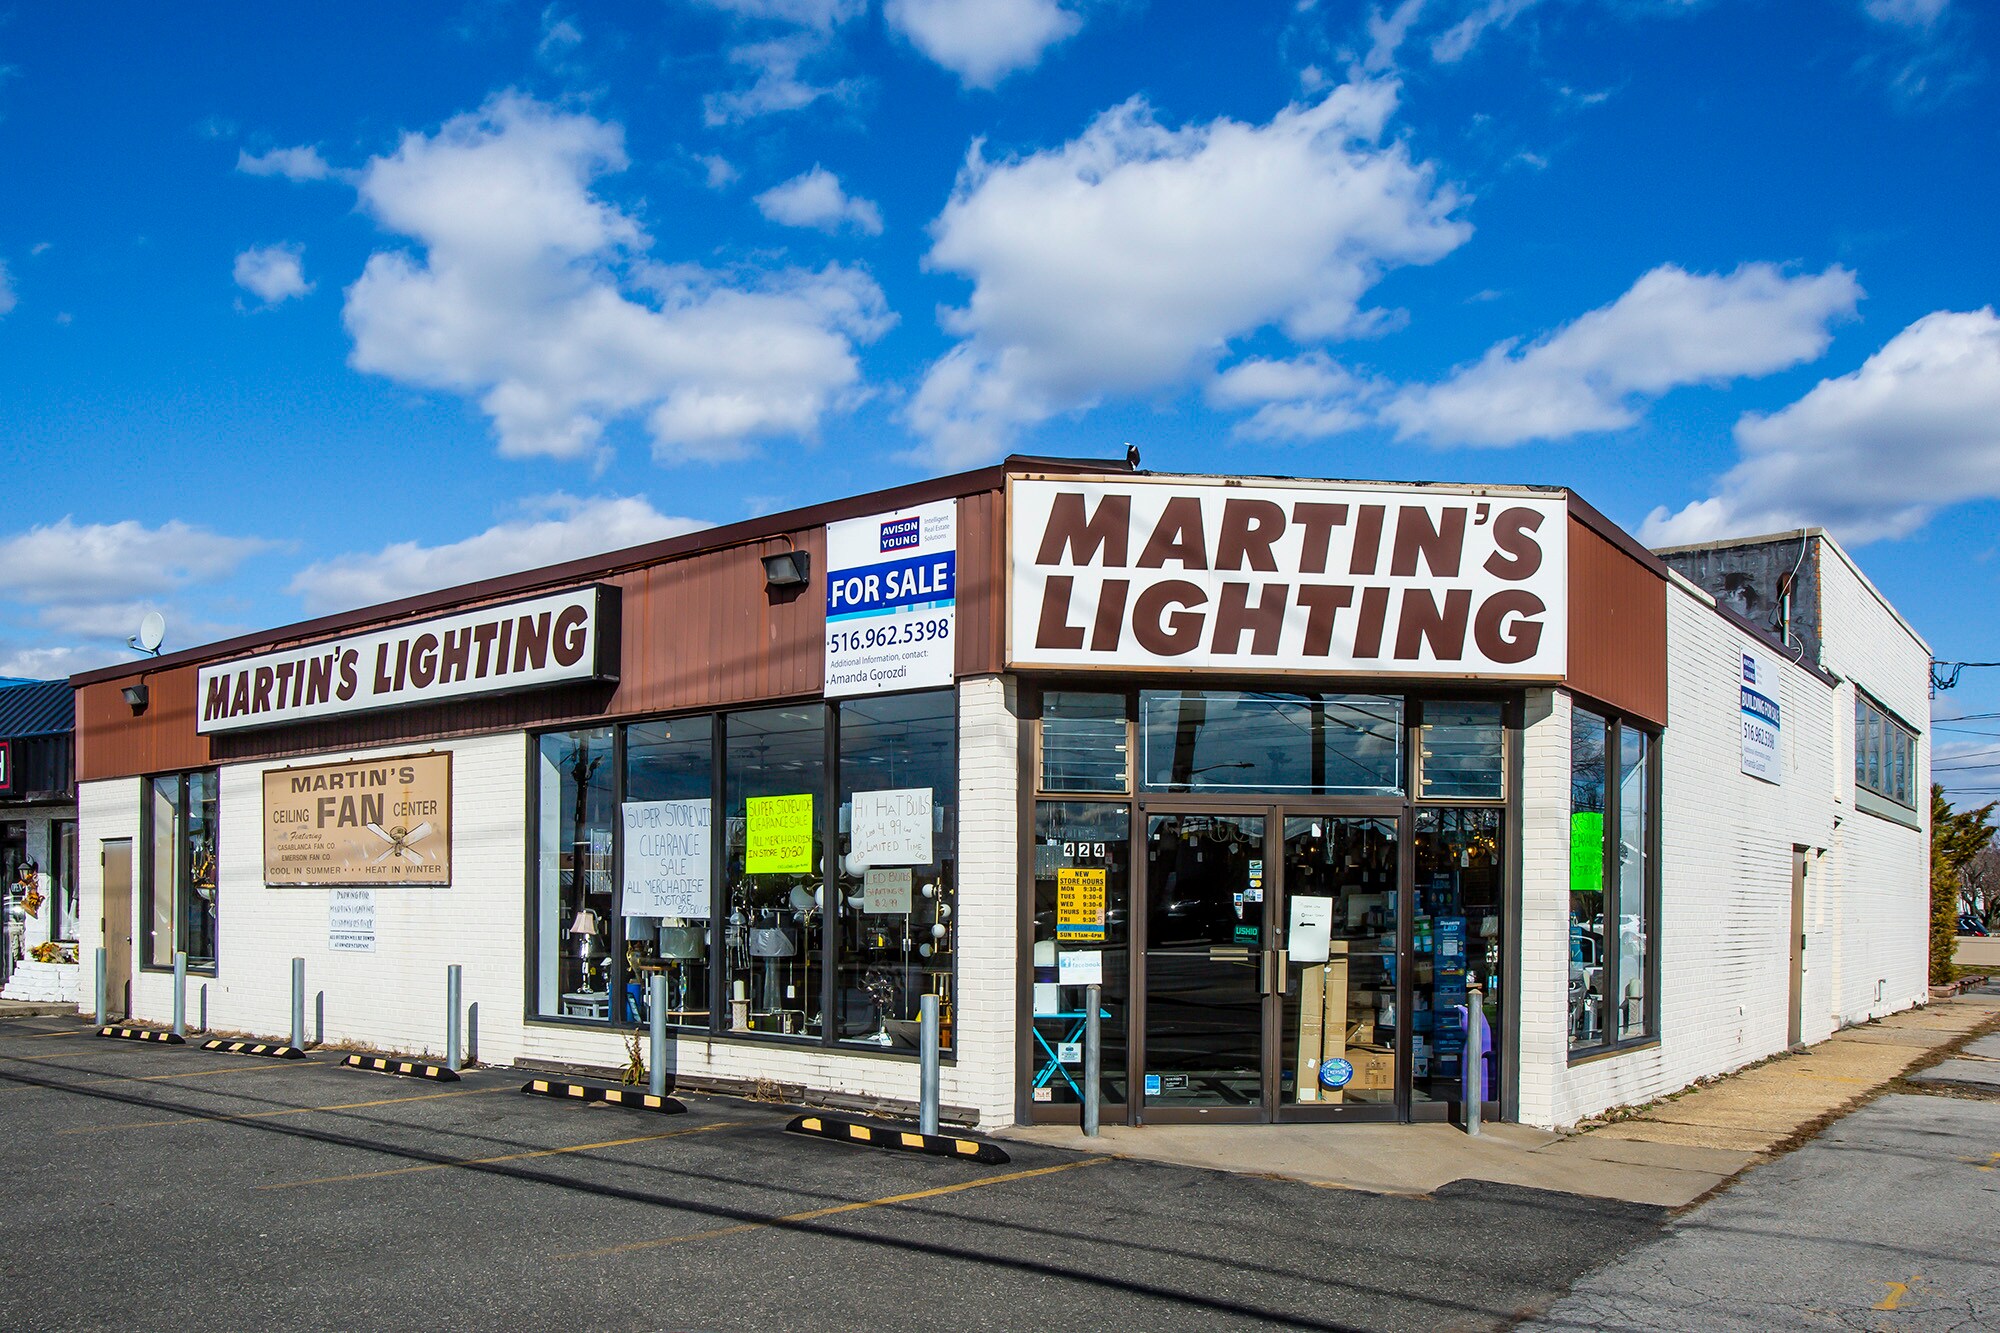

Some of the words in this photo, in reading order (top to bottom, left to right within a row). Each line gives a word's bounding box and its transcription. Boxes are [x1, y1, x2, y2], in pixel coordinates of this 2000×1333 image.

[924, 515, 949, 525] Intelligent
[936, 524, 950, 532] Estate
[882, 521, 918, 536] AVISON
[882, 534, 918, 549] YOUNG
[924, 533, 947, 542] Solutions
[1035, 493, 1545, 581] MARTIN'S
[831, 574, 880, 608] FOR
[885, 562, 948, 600] SALE
[1035, 575, 1546, 664] LIGHTING
[830, 618, 949, 653] 516.962.5398
[204, 646, 359, 722] MARTIN'S
[373, 604, 589, 695] LIGHTING
[830, 656, 862, 668] Additional
[862, 652, 900, 665] Information,
[902, 650, 929, 661] contact:
[830, 670, 868, 685] Amanda
[870, 665, 907, 681] Gorozdi
[291, 766, 415, 793] MARTIN'S
[273, 808, 310, 824] CEILING
[317, 793, 384, 829] FAN
[393, 800, 438, 817] CENTER
[748, 800, 774, 817] SUPER
[627, 806, 662, 829] SUPER
[290, 831, 322, 842] Featuring
[640, 832, 700, 857] CLEARANCE
[752, 836, 764, 847] ALL
[278, 844, 312, 852] CASABLANCA
[282, 854, 308, 862] EMERSON
[270, 867, 290, 875] COOL
[306, 866, 341, 874] SUMMER
[366, 866, 387, 874] HEAT
[391, 866, 400, 874] IN
[406, 865, 442, 874] WINTER
[660, 858, 686, 876] SALE
[626, 880, 642, 894] ALL
[866, 872, 886, 886] LED
[1236, 926, 1258, 936] USHIO
